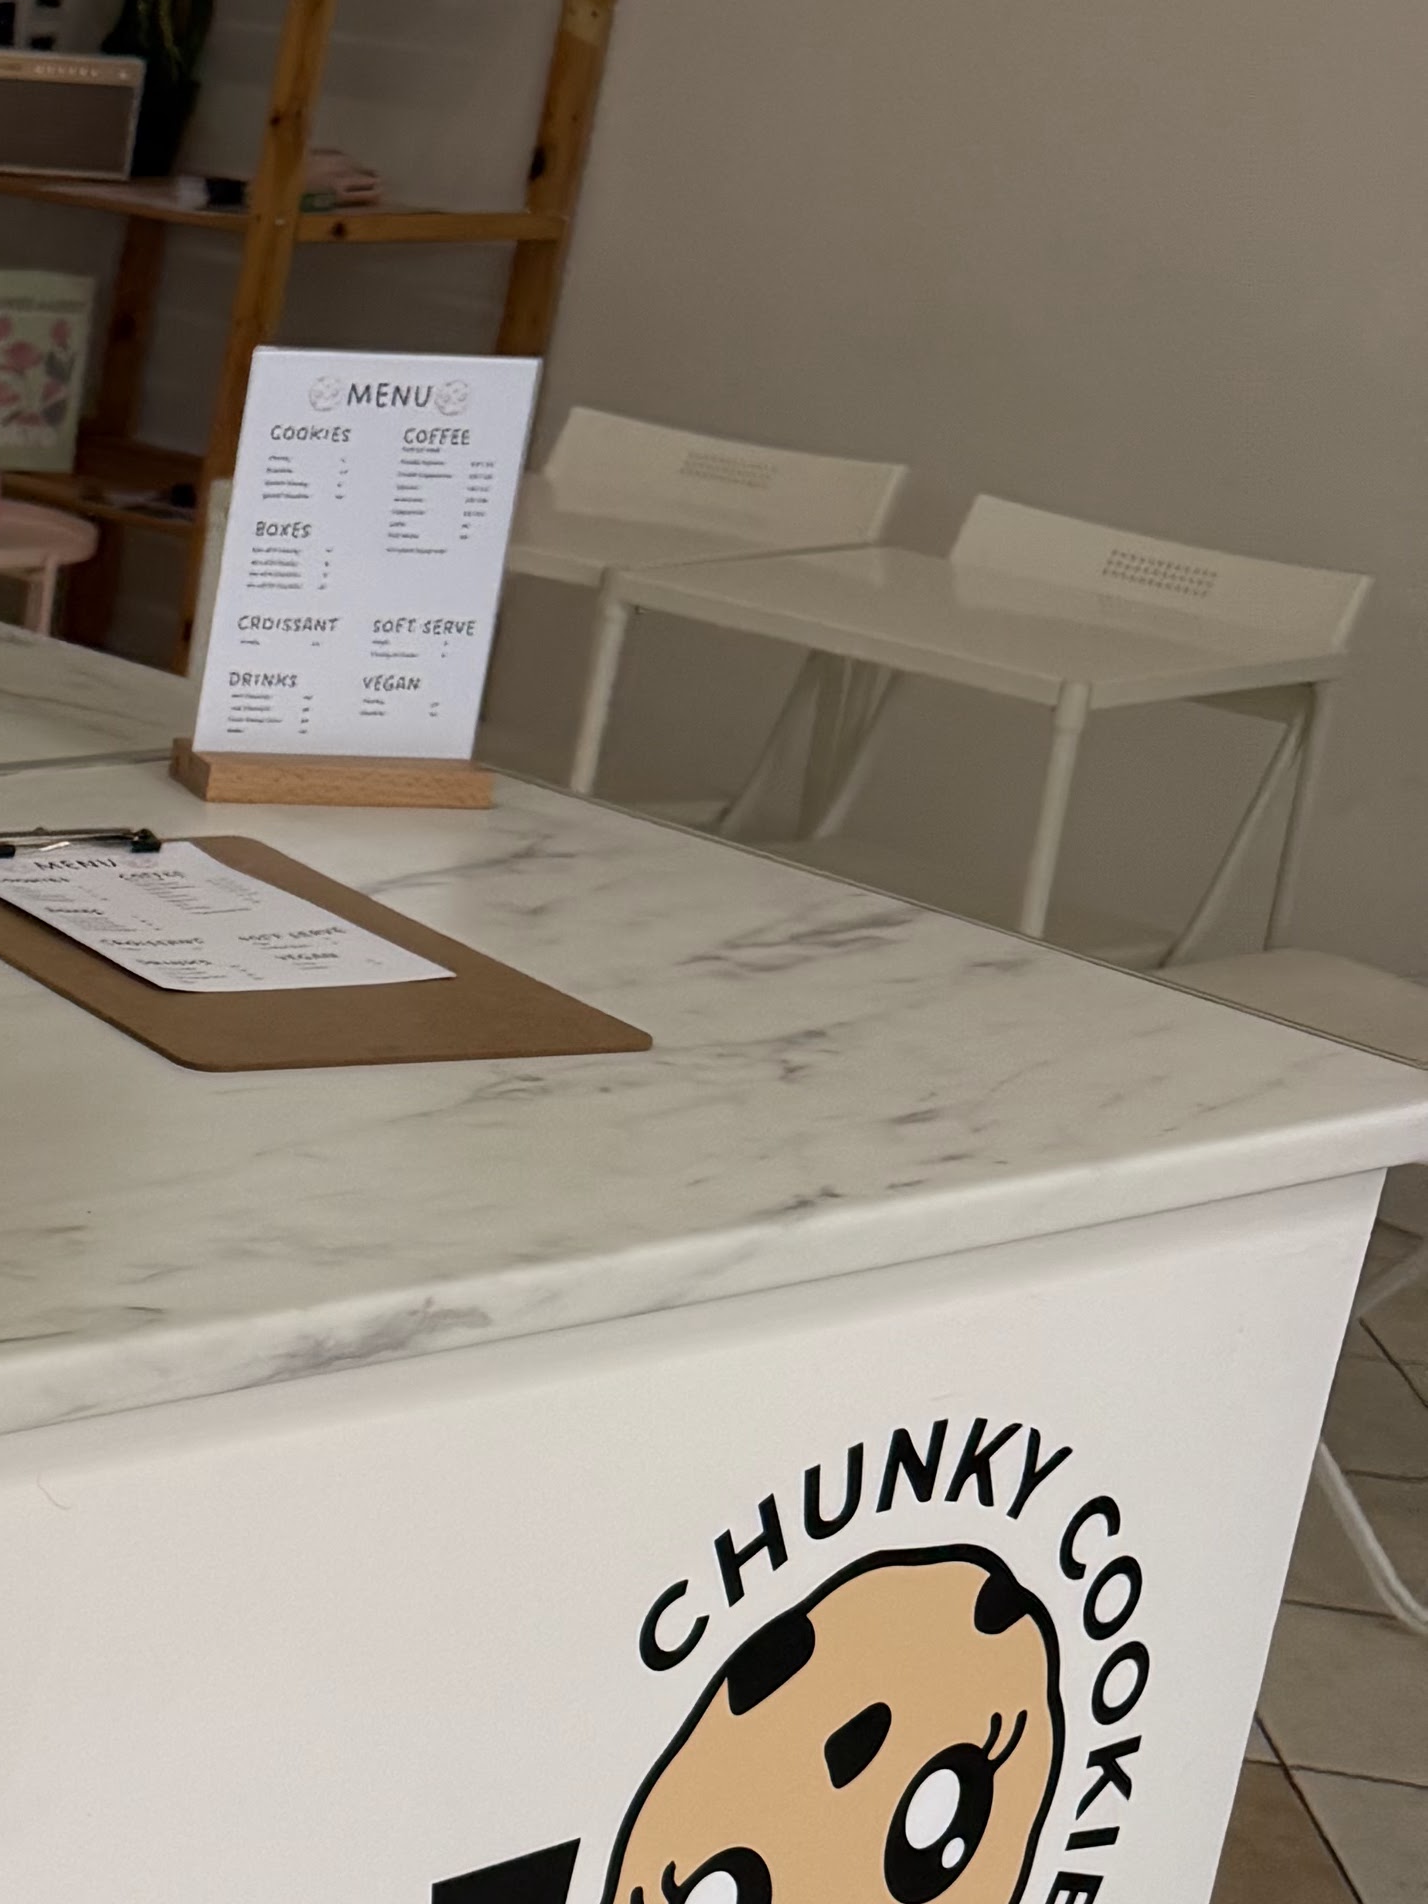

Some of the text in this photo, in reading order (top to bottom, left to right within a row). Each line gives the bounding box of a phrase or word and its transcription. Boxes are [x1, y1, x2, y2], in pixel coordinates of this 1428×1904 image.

[347, 381, 434, 409] MENU
[270, 424, 351, 444] COOKIES
[403, 427, 471, 446] COFFEE
[256, 520, 312, 539] BOXES
[237, 615, 339, 634] CROISSANT
[422, 618, 477, 637] SERVE
[362, 674, 422, 693] VEGAN
[637, 1417, 1073, 1672] CHUNKY
